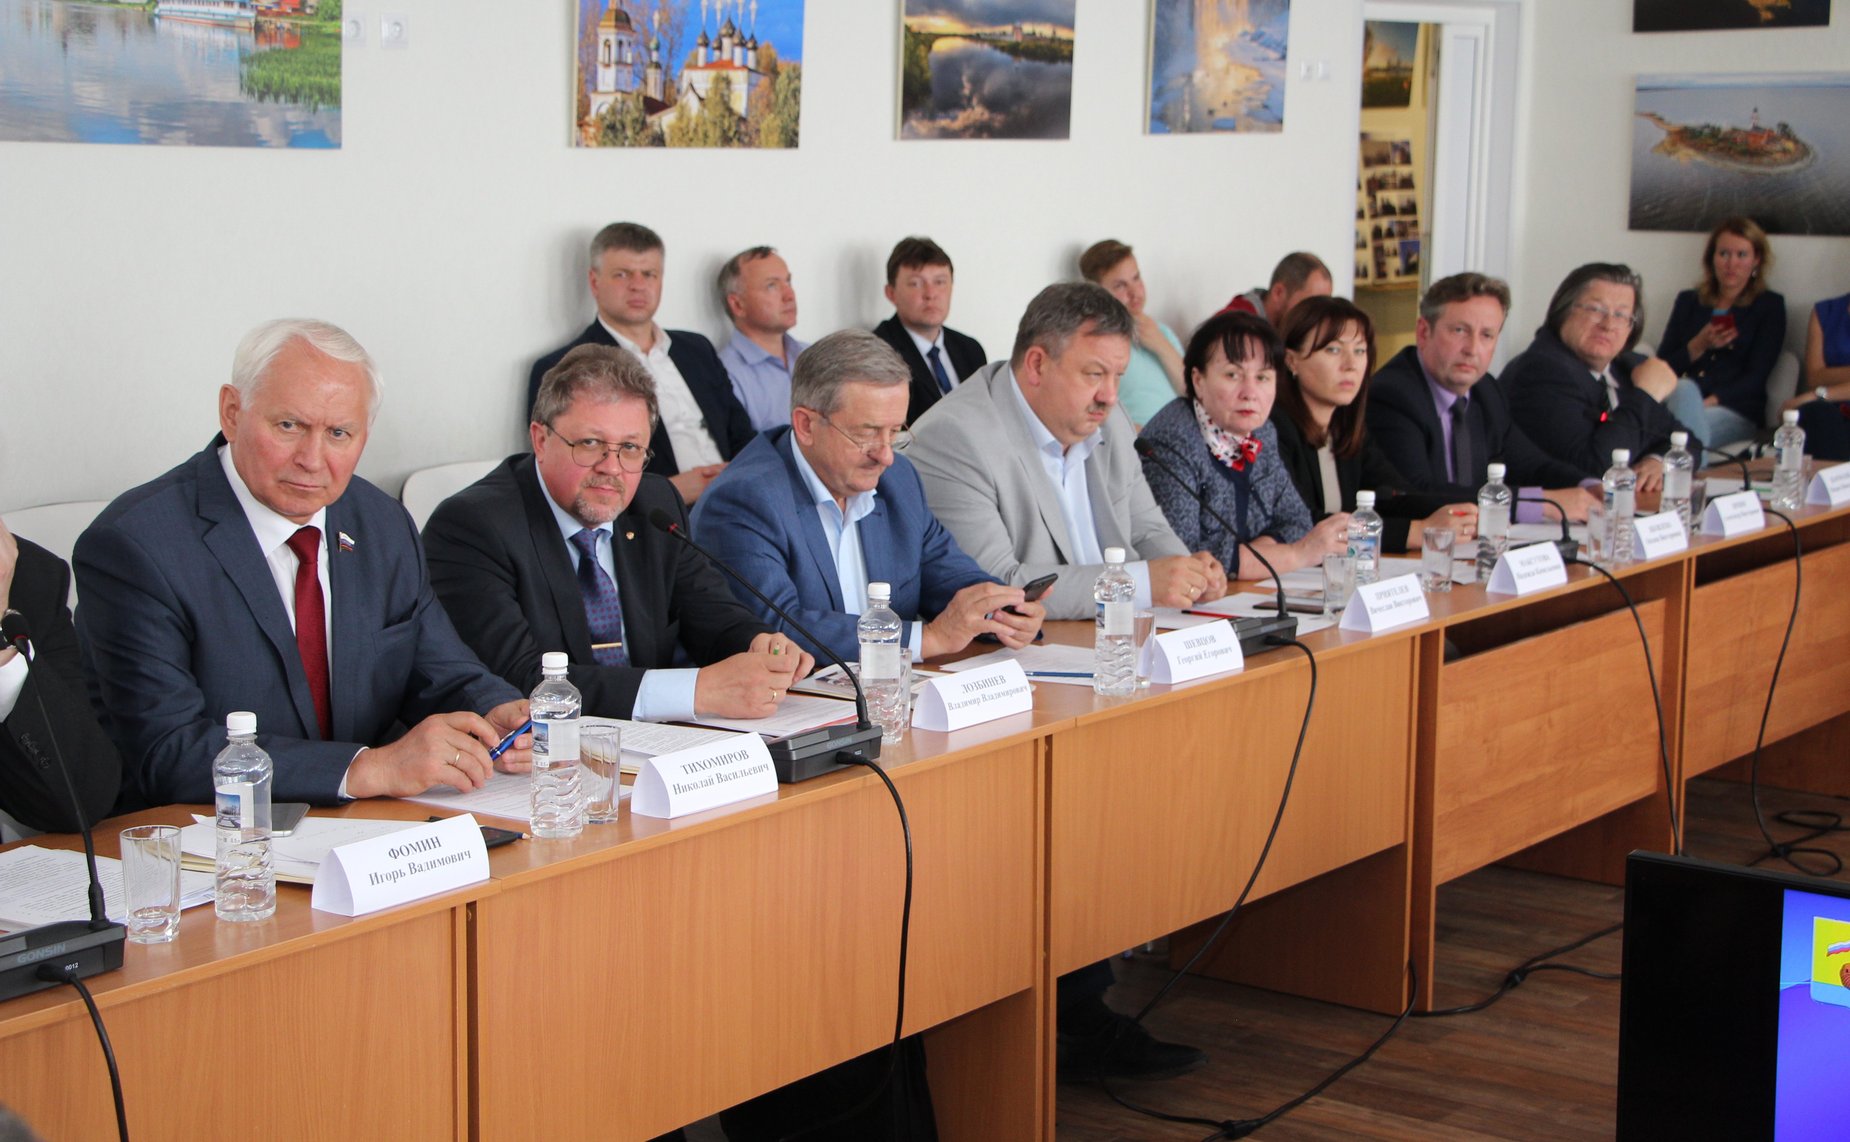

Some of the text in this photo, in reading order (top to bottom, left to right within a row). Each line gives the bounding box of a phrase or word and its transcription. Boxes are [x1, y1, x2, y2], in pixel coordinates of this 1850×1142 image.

[1183, 634, 1217, 650] ШЕВЦОВ
[947, 685, 1028, 712] Владимир Владимирович
[680, 749, 750, 776] ТИХОМИРОВ
[672, 763, 770, 796] Николай Васильевич
[388, 836, 442, 861] ФОМИН
[368, 849, 473, 887] Игорь Вадимович
[17, 943, 66, 964] GONSIN
